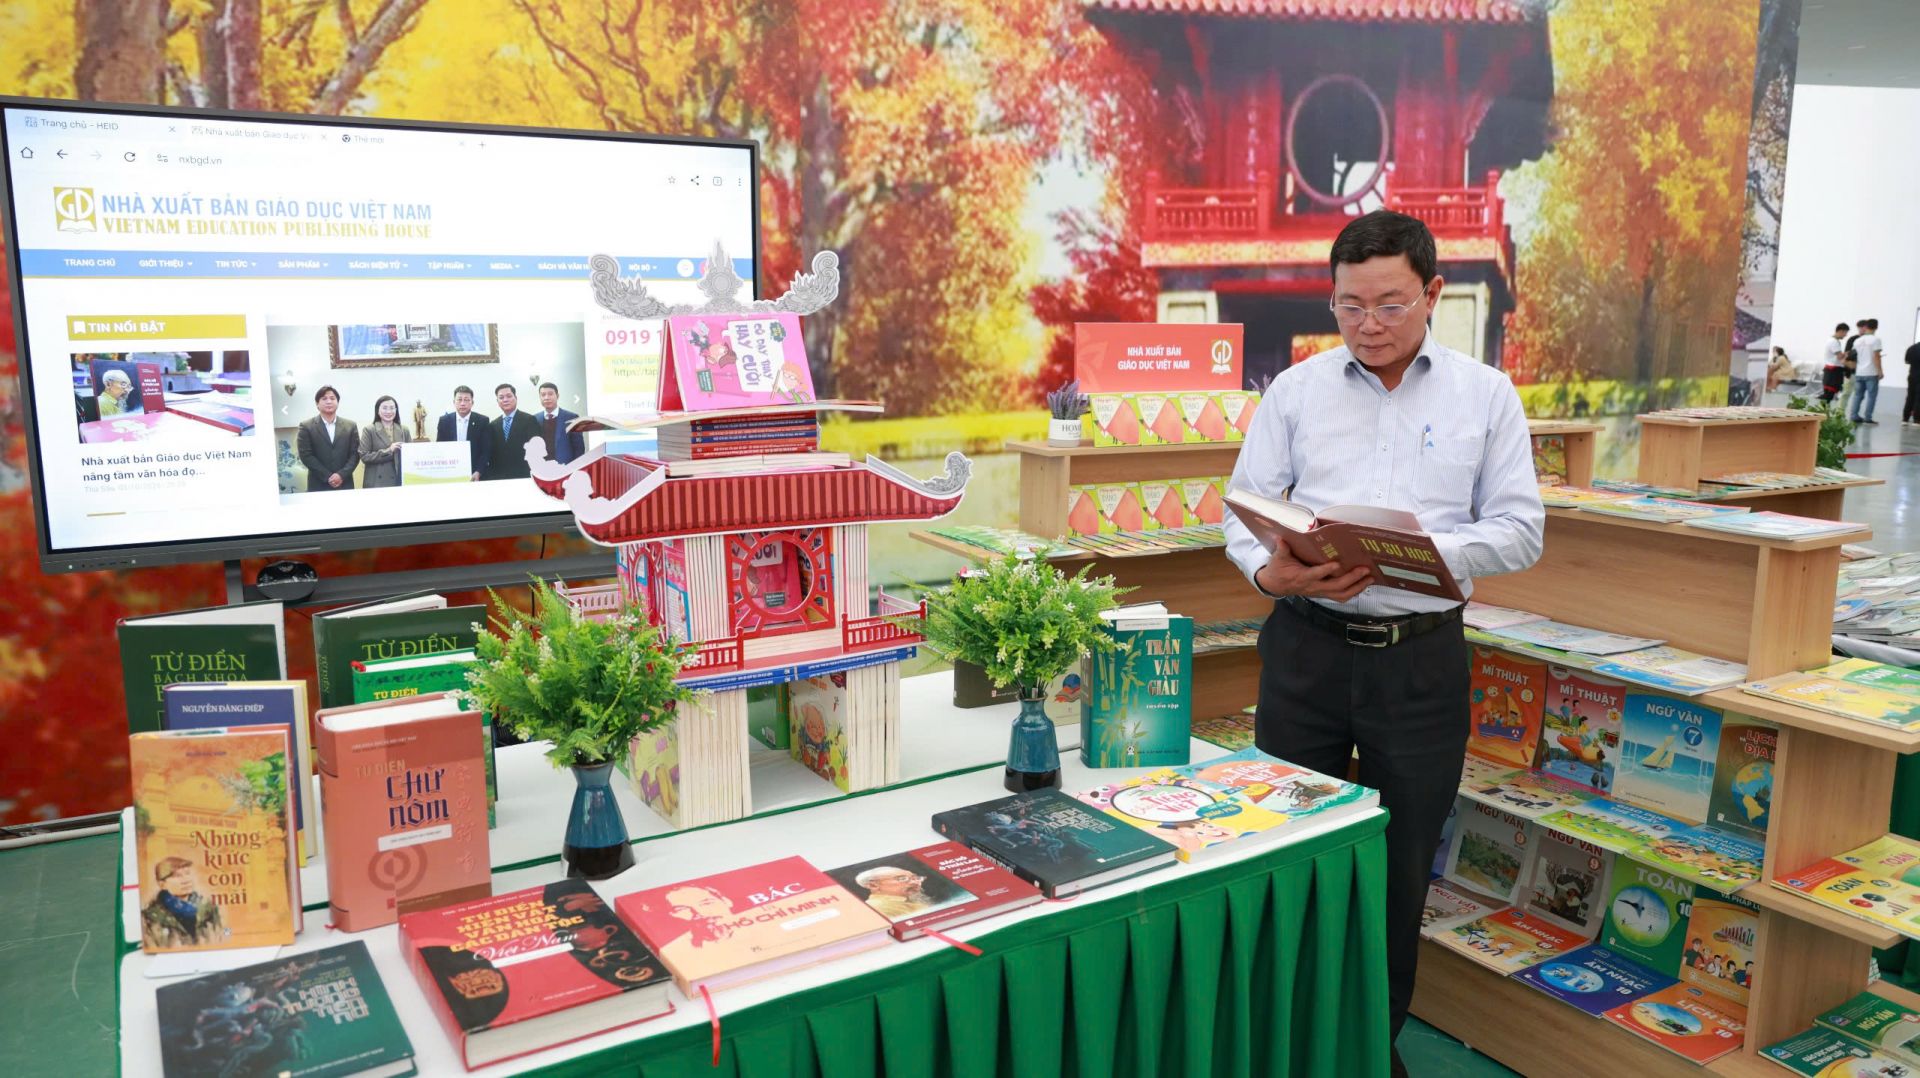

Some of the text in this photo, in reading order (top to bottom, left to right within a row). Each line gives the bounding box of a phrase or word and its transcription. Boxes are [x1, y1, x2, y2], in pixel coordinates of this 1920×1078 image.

[41, 118, 67, 130] Trang
[97, 122, 119, 131] HEID
[179, 155, 222, 167] nxbgd.vn
[102, 191, 432, 223] NHÀ XUẤT BẢN GIÁO DỤC VIỆT NAM
[103, 217, 432, 239] VIETNAM EDUCATION PUBLISHING HOUSE
[64, 258, 95, 267] TRANG
[88, 319, 166, 335] TIN NỔI BẬT
[605, 329, 651, 345] 0919
[1127, 344, 1182, 357] NHÀ XUẤT BẢN
[1118, 358, 1190, 372] GIÁO DỤC VIỆT NAM
[81, 449, 252, 467] Nhà xuất bản Giáo dục Việt Nam
[83, 471, 111, 483] nâng
[137, 468, 157, 479] văn
[159, 467, 179, 478] hóa
[361, 632, 458, 661] TỪ ĐIỂN
[1146, 631, 1181, 656] TRẦN
[150, 649, 246, 672] TỪ ĐIỂN
[1154, 655, 1180, 676] VĂN
[153, 672, 248, 684] BÁCH KHOA
[1495, 668, 1529, 686] THUẬT
[1147, 675, 1179, 696] GIÀU
[1577, 689, 1617, 707] THUẬT
[182, 704, 218, 713] NGUYỄN
[244, 704, 264, 714] ĐIỆP
[1647, 703, 1703, 725] NGỮ VĂN
[1688, 730, 1700, 745] 7
[1140, 791, 1197, 806] TIẾNG
[1157, 798, 1199, 812] VIỆT
[1503, 814, 1524, 830] VĂN
[190, 829, 262, 850] Những
[1578, 841, 1603, 857] VĂN
[1590, 858, 1599, 870] 9
[1878, 851, 1917, 867] TOÁN
[1635, 867, 1693, 899] TOÁN
[1826, 877, 1865, 893] TOÁN
[747, 882, 806, 905] BÁC
[787, 895, 840, 914] MINH
[1458, 899, 1480, 911] VĂN
[450, 937, 493, 953] CÁC
[543, 915, 585, 931] TỘC
[520, 929, 579, 950] Nam
[1512, 921, 1564, 944] ÂM NHẠC
[1584, 961, 1607, 972] ÂM
[1606, 971, 1646, 990] NHẠC
[1616, 986, 1632, 995] 10
[1677, 999, 1718, 1020] LỊCH
[1875, 1008, 1896, 1021] VĂN
[1716, 1028, 1733, 1038] 10
